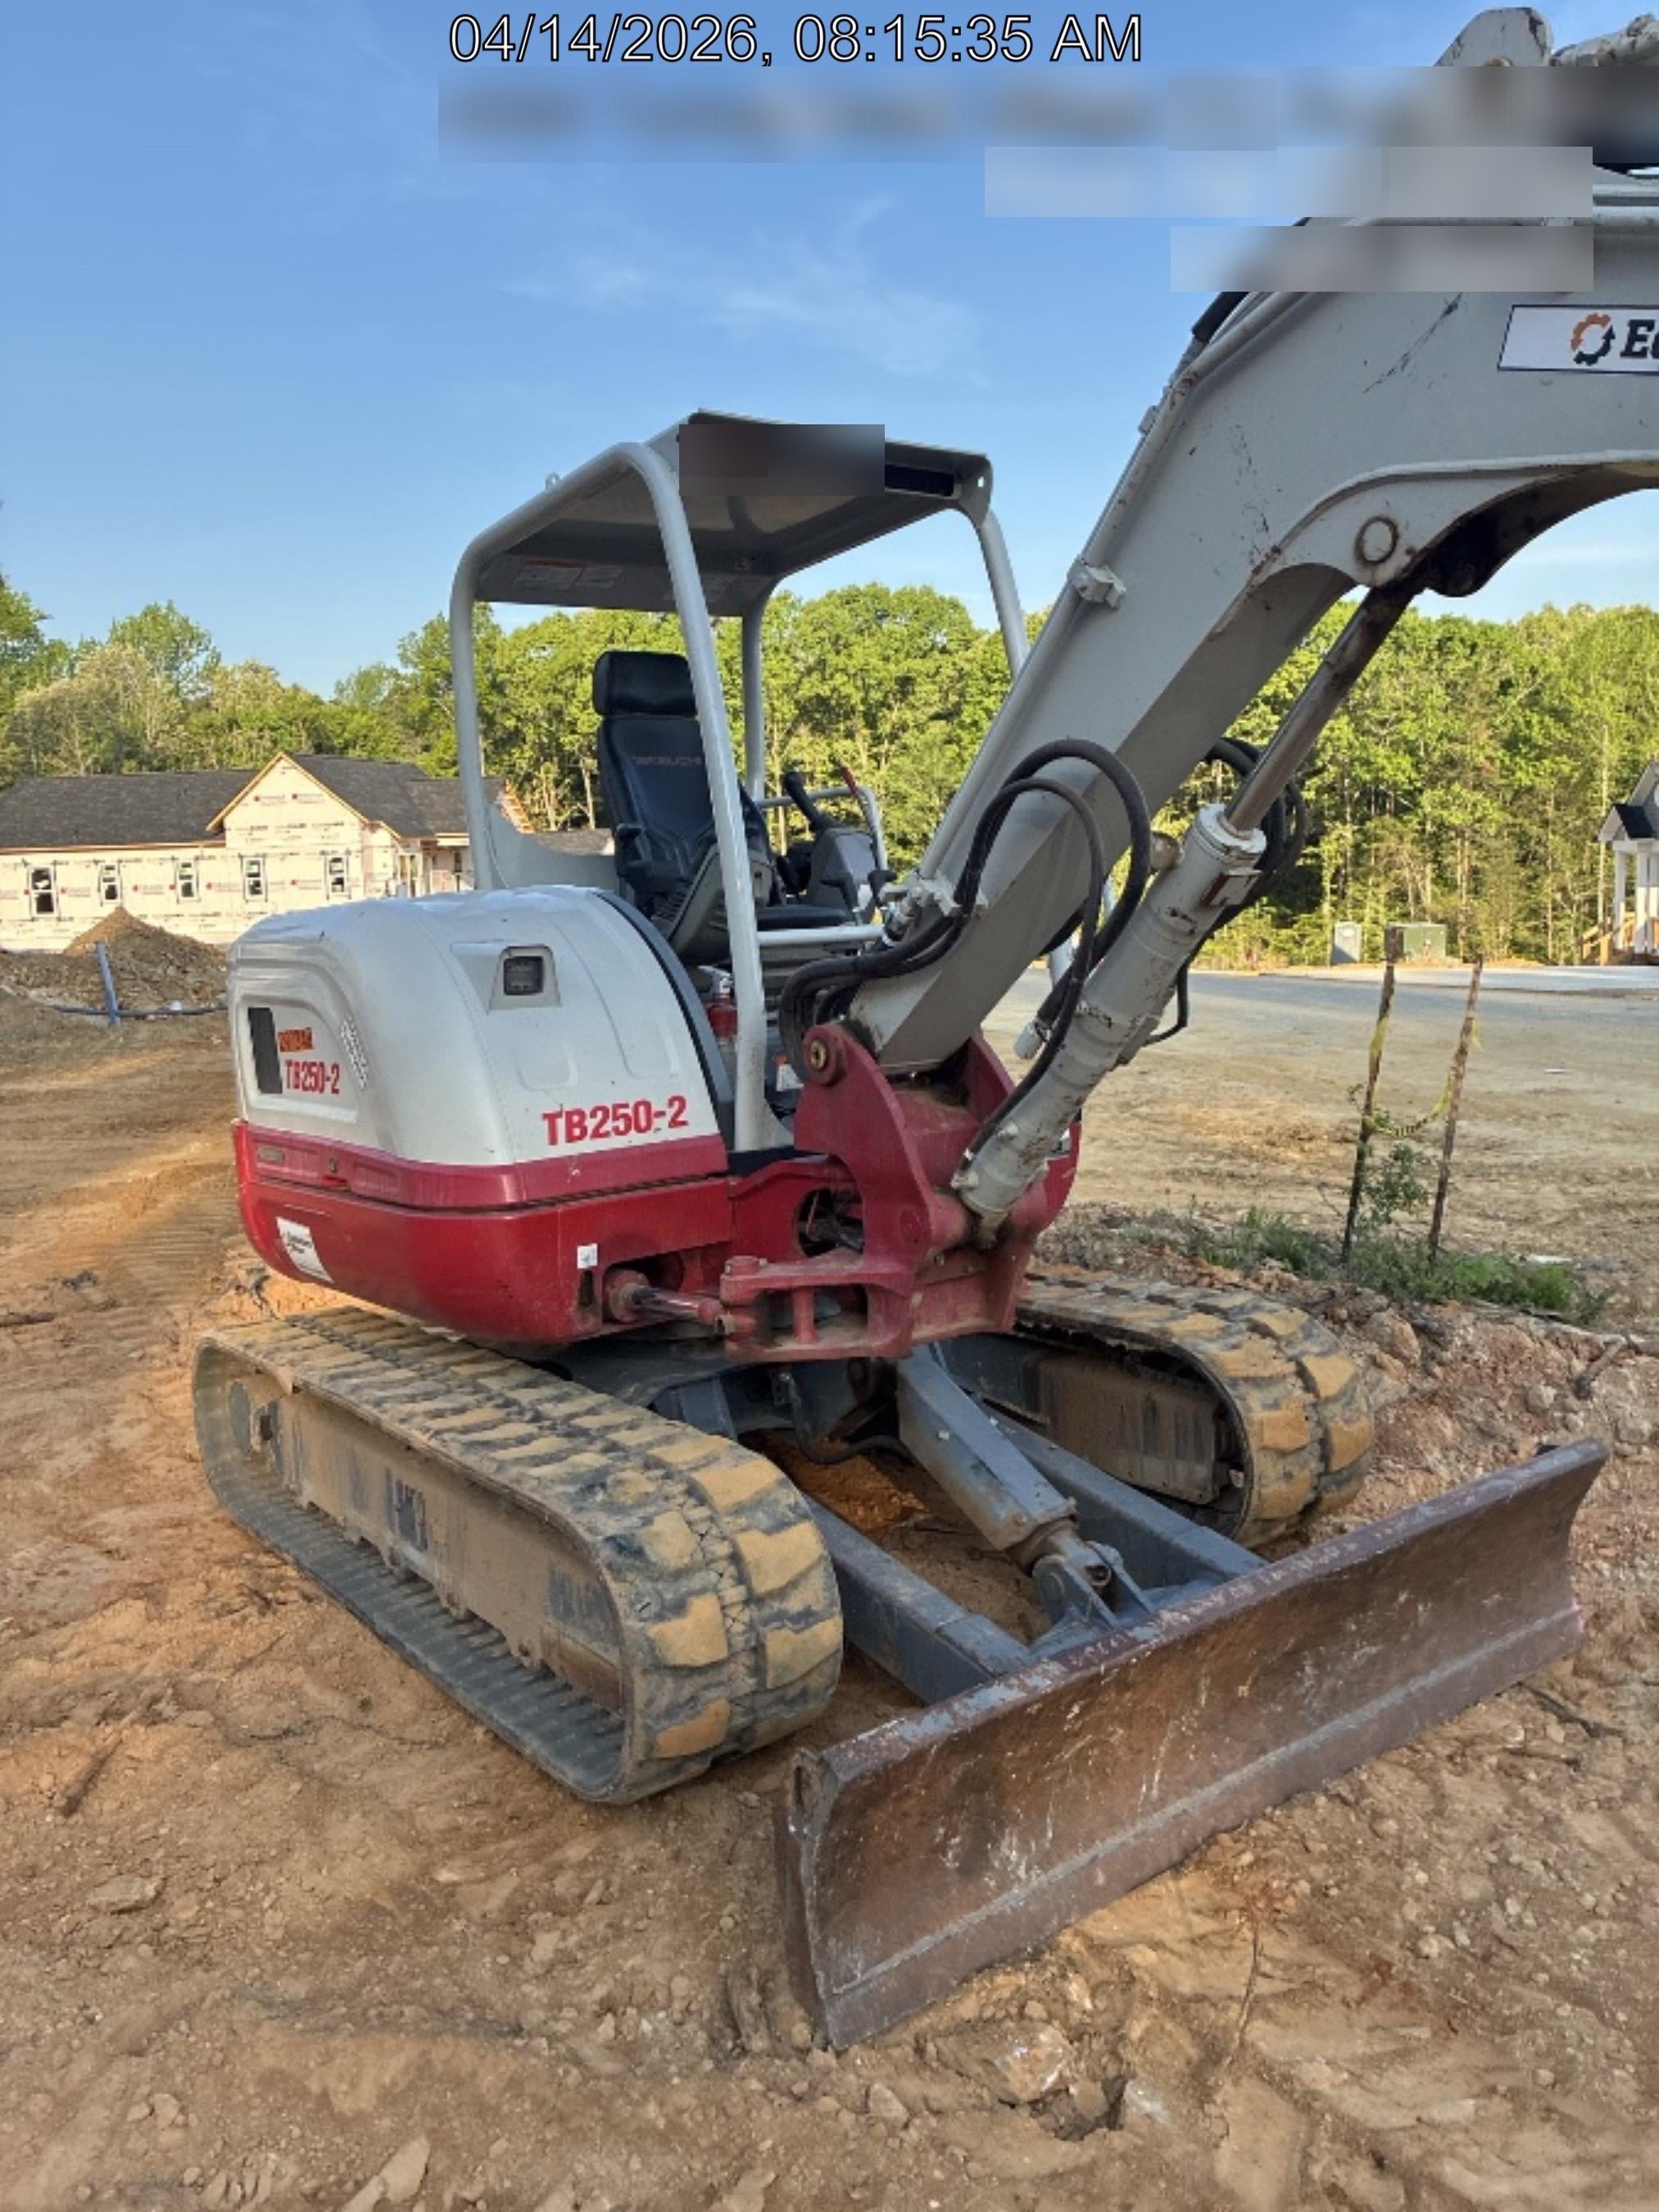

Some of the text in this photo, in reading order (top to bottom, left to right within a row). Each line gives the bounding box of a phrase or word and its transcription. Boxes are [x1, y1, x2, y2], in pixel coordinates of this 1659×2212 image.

[1620, 319, 1659, 358] E
[284, 1058, 341, 1095] TB250-2
[542, 1095, 689, 1146] TB250-2
